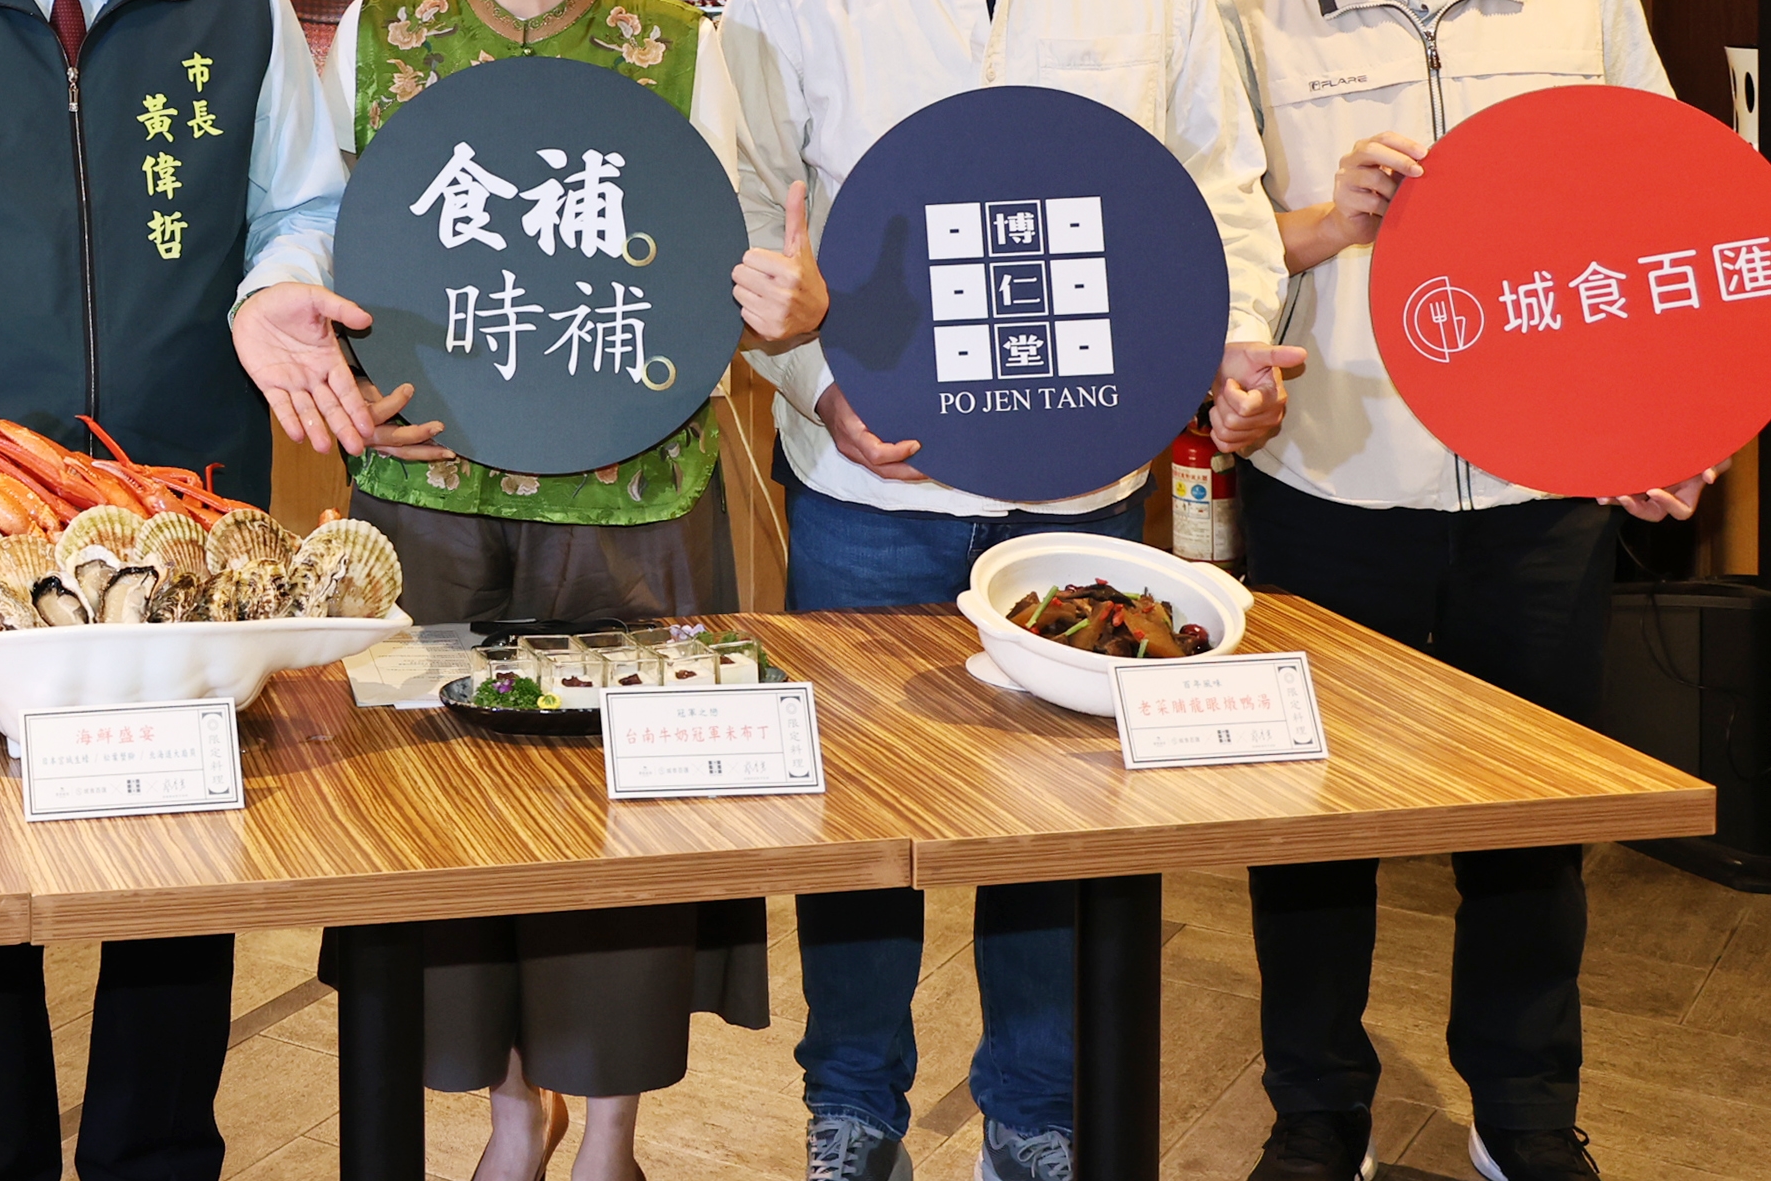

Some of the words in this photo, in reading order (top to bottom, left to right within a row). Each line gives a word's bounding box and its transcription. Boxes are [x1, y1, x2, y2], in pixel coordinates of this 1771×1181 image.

[182, 51, 223, 139] 市長
[136, 93, 188, 260] 黃偉哲
[993, 211, 1045, 367] 博仁堂
[1497, 236, 1771, 335] 城食百匯
[939, 391, 976, 414] PO
[982, 389, 1031, 413] JEN
[1038, 384, 1119, 409] TANG
[76, 725, 155, 745] 海鮮盛宴
[626, 725, 769, 745] 台南牛奶冠軍米布丁
